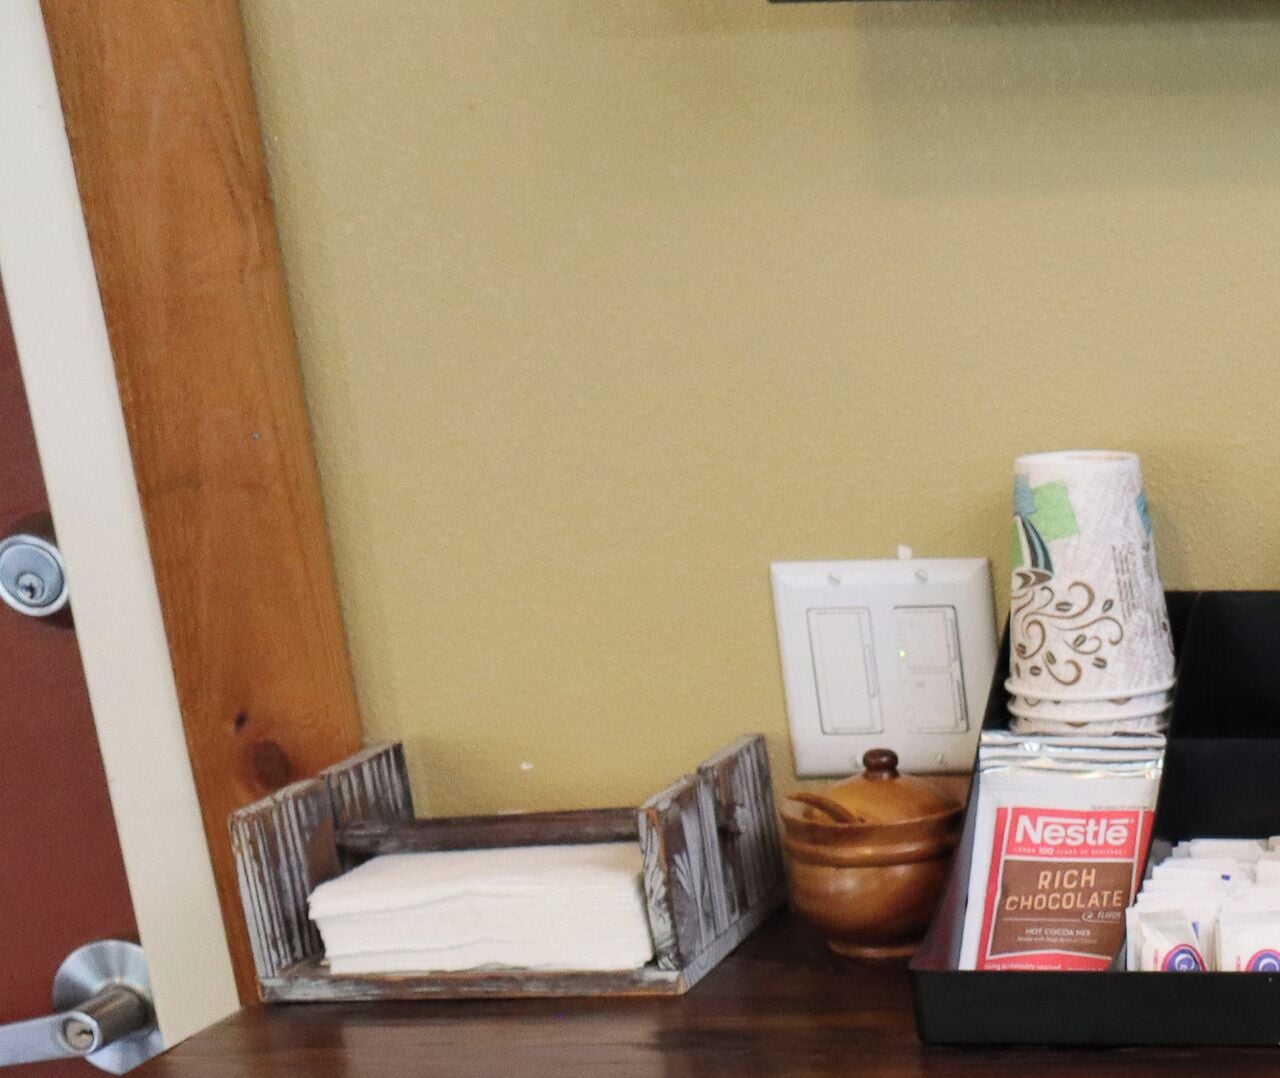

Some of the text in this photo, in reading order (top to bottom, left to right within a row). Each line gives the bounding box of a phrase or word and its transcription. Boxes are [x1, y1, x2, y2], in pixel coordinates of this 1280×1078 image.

[1015, 815, 1131, 847] Nestlé
[1038, 868, 1096, 890] RICH
[1005, 890, 1124, 911] CHOCOLATE
